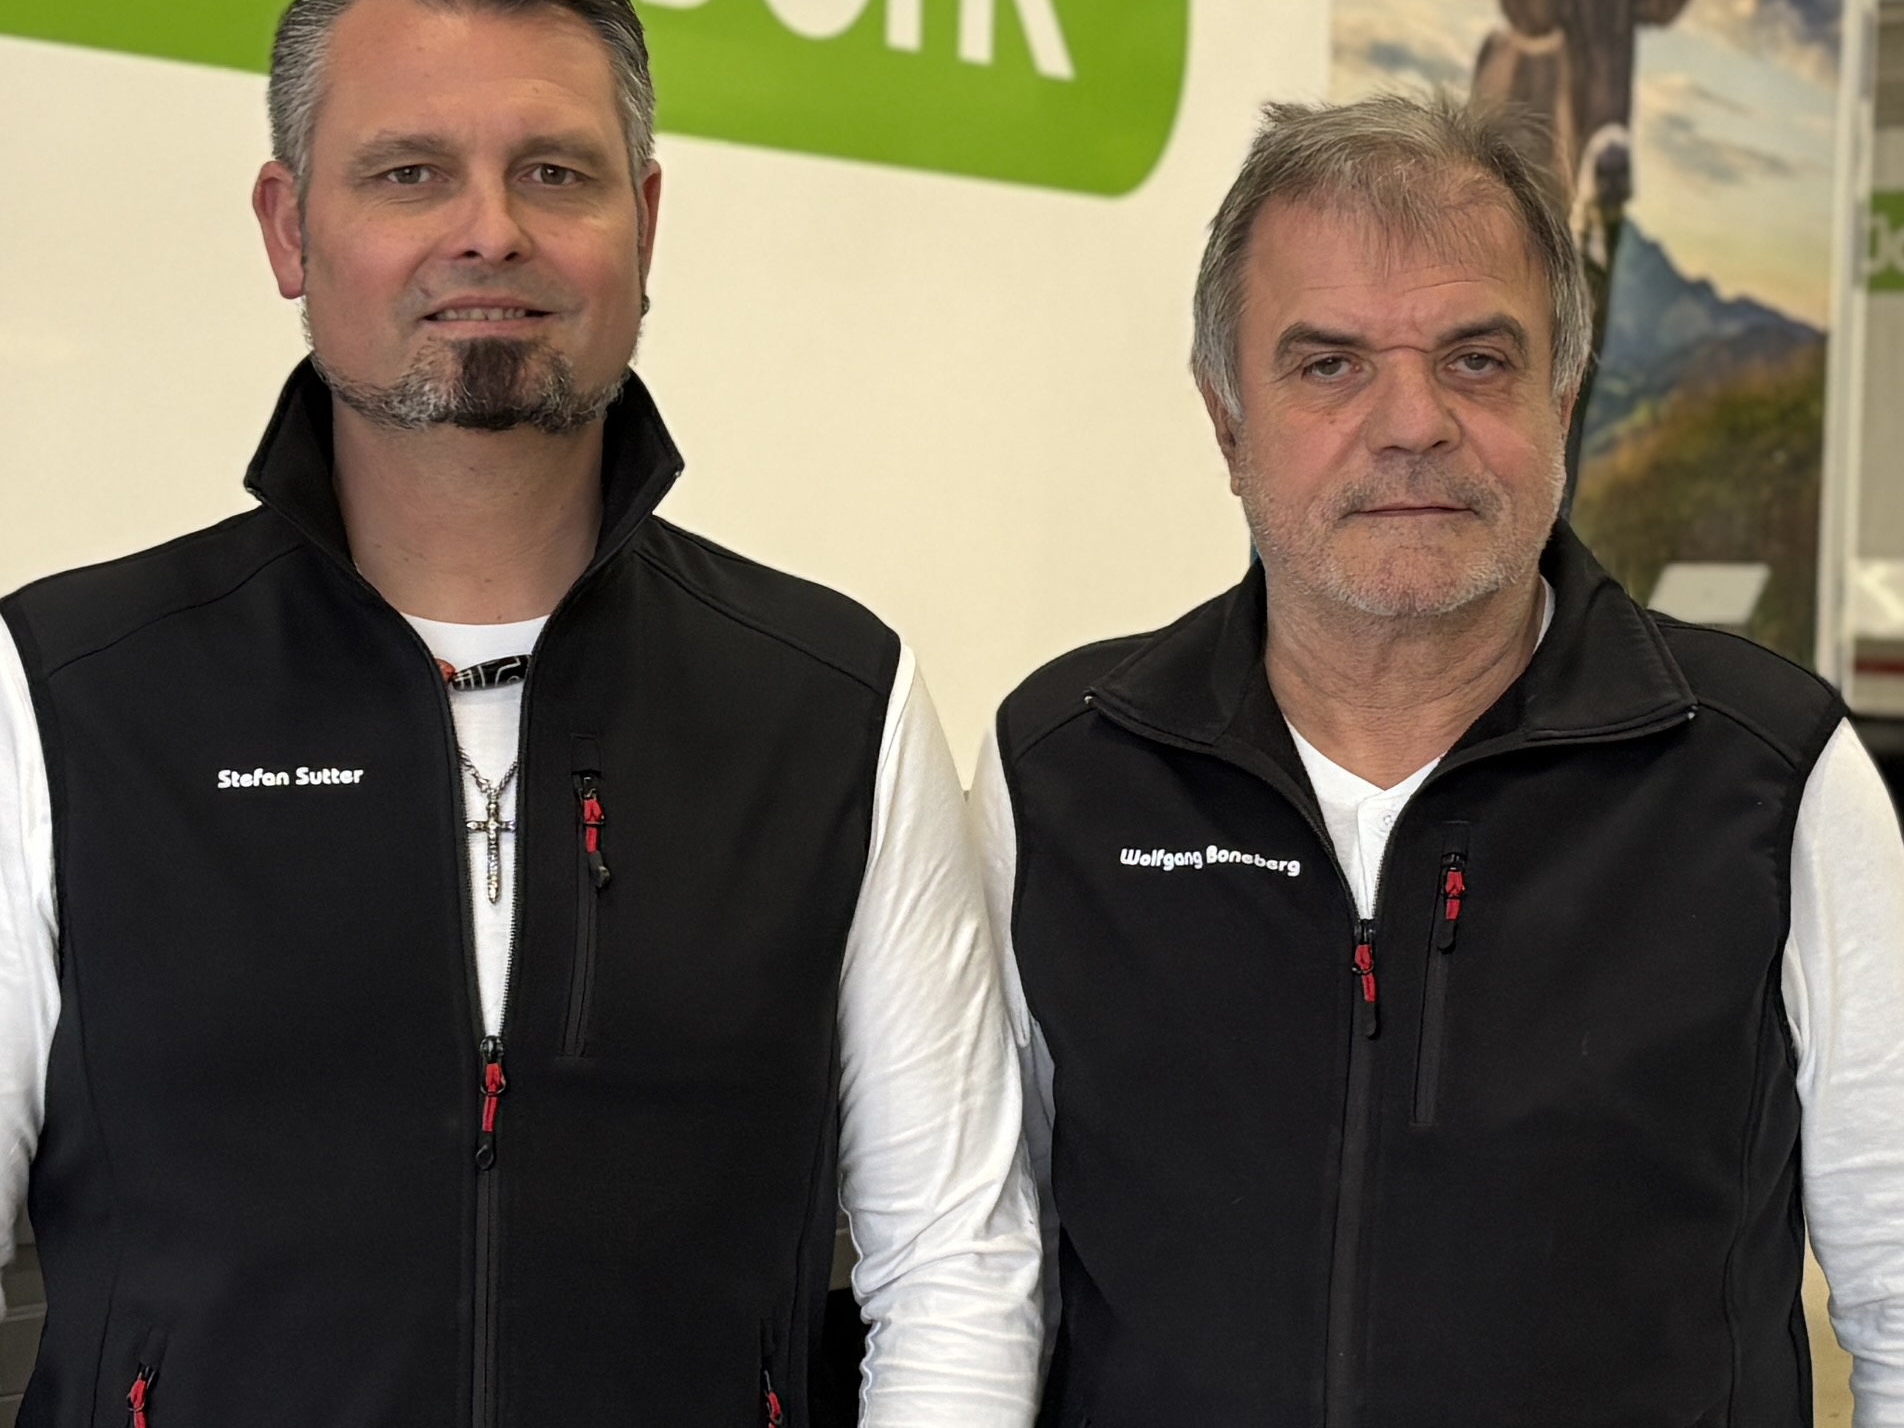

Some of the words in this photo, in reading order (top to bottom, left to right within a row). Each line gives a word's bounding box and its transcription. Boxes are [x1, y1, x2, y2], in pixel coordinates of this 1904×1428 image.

[217, 767, 290, 789] Stefan
[295, 766, 364, 786] Sutter
[1119, 847, 1203, 871] Wolfgang
[1205, 844, 1301, 877] Boneberg
